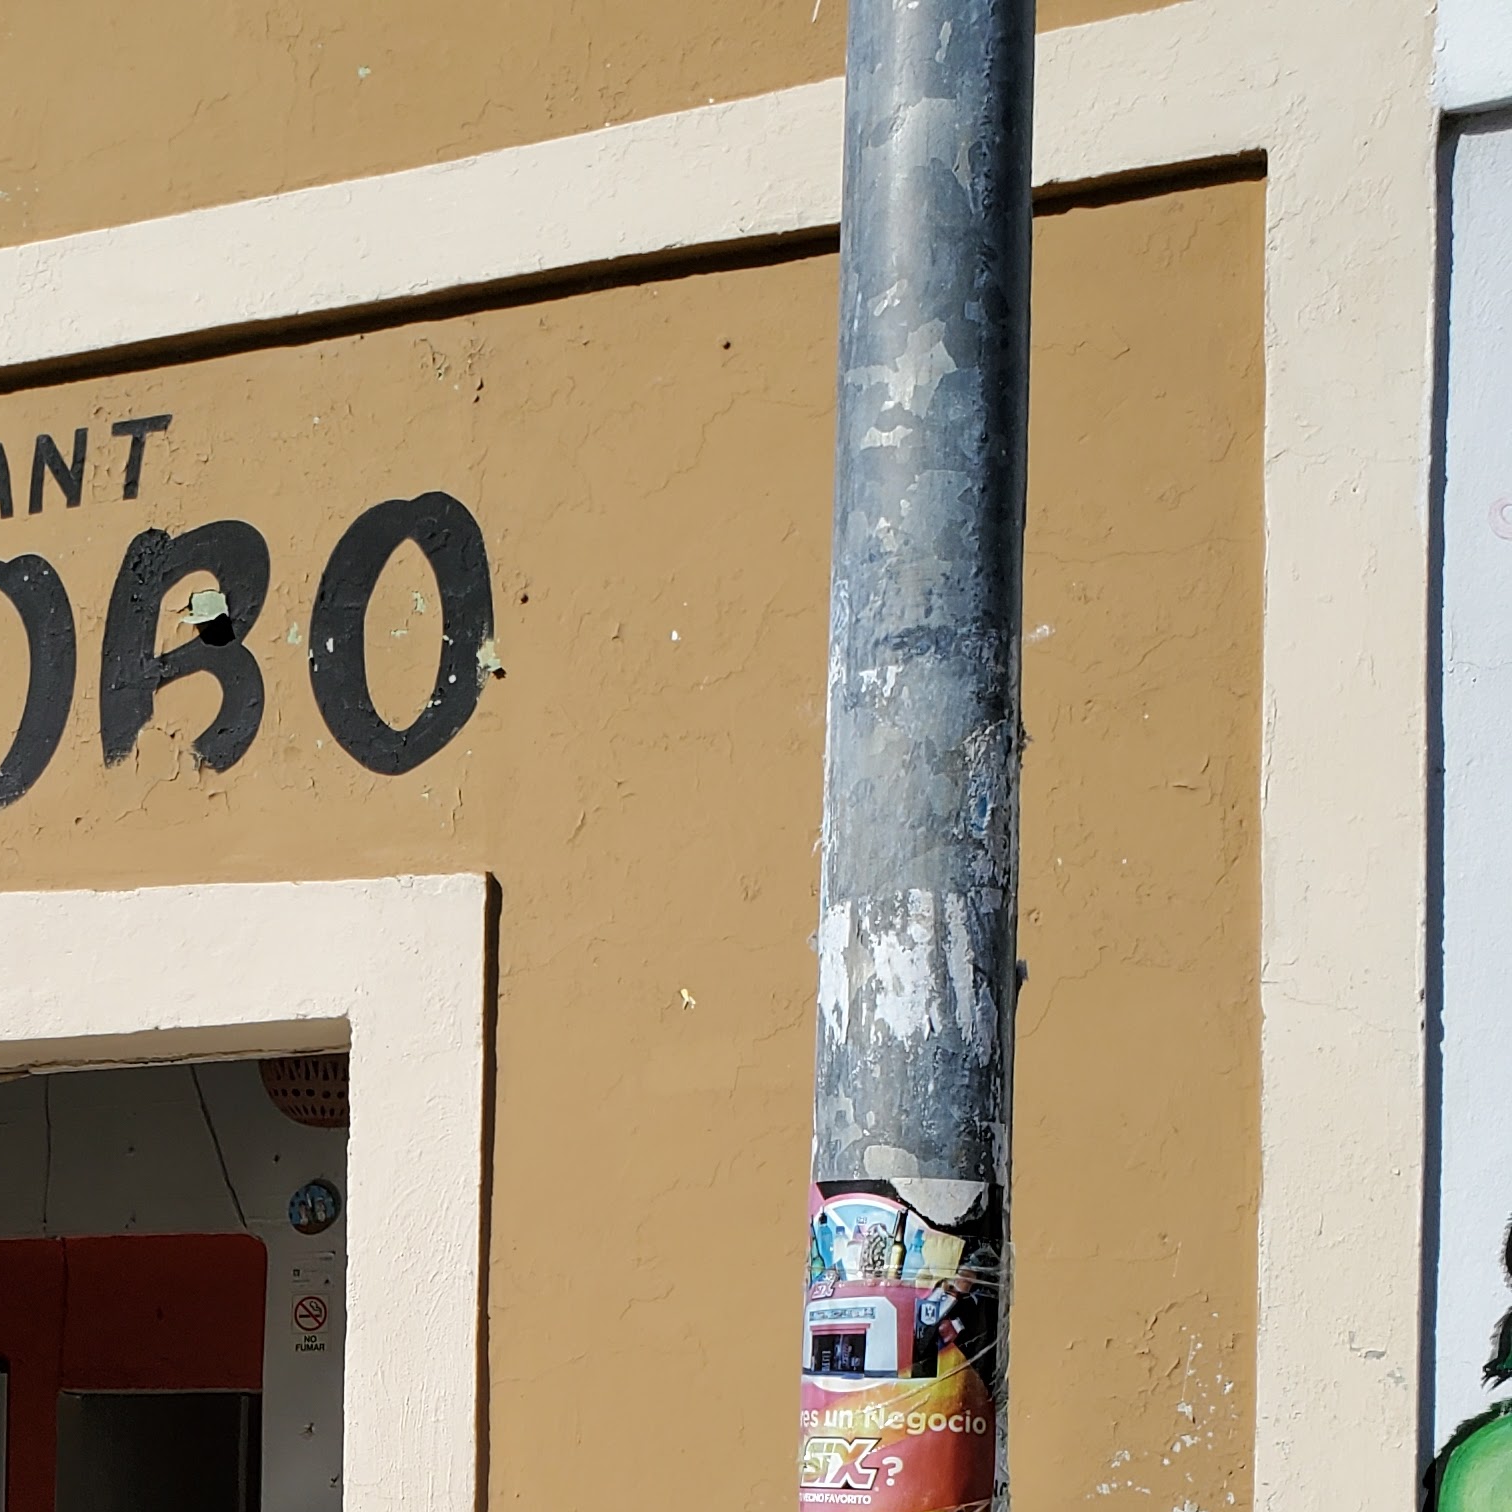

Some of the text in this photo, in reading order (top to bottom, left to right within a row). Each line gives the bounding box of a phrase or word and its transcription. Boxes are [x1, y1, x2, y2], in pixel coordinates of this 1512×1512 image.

[304, 1335, 317, 1344] NO
[295, 1343, 325, 1352] FUMAR
[824, 1409, 853, 1428] un
[863, 1403, 987, 1435] Negocio
[825, 1493, 872, 1505] FAVORITO
